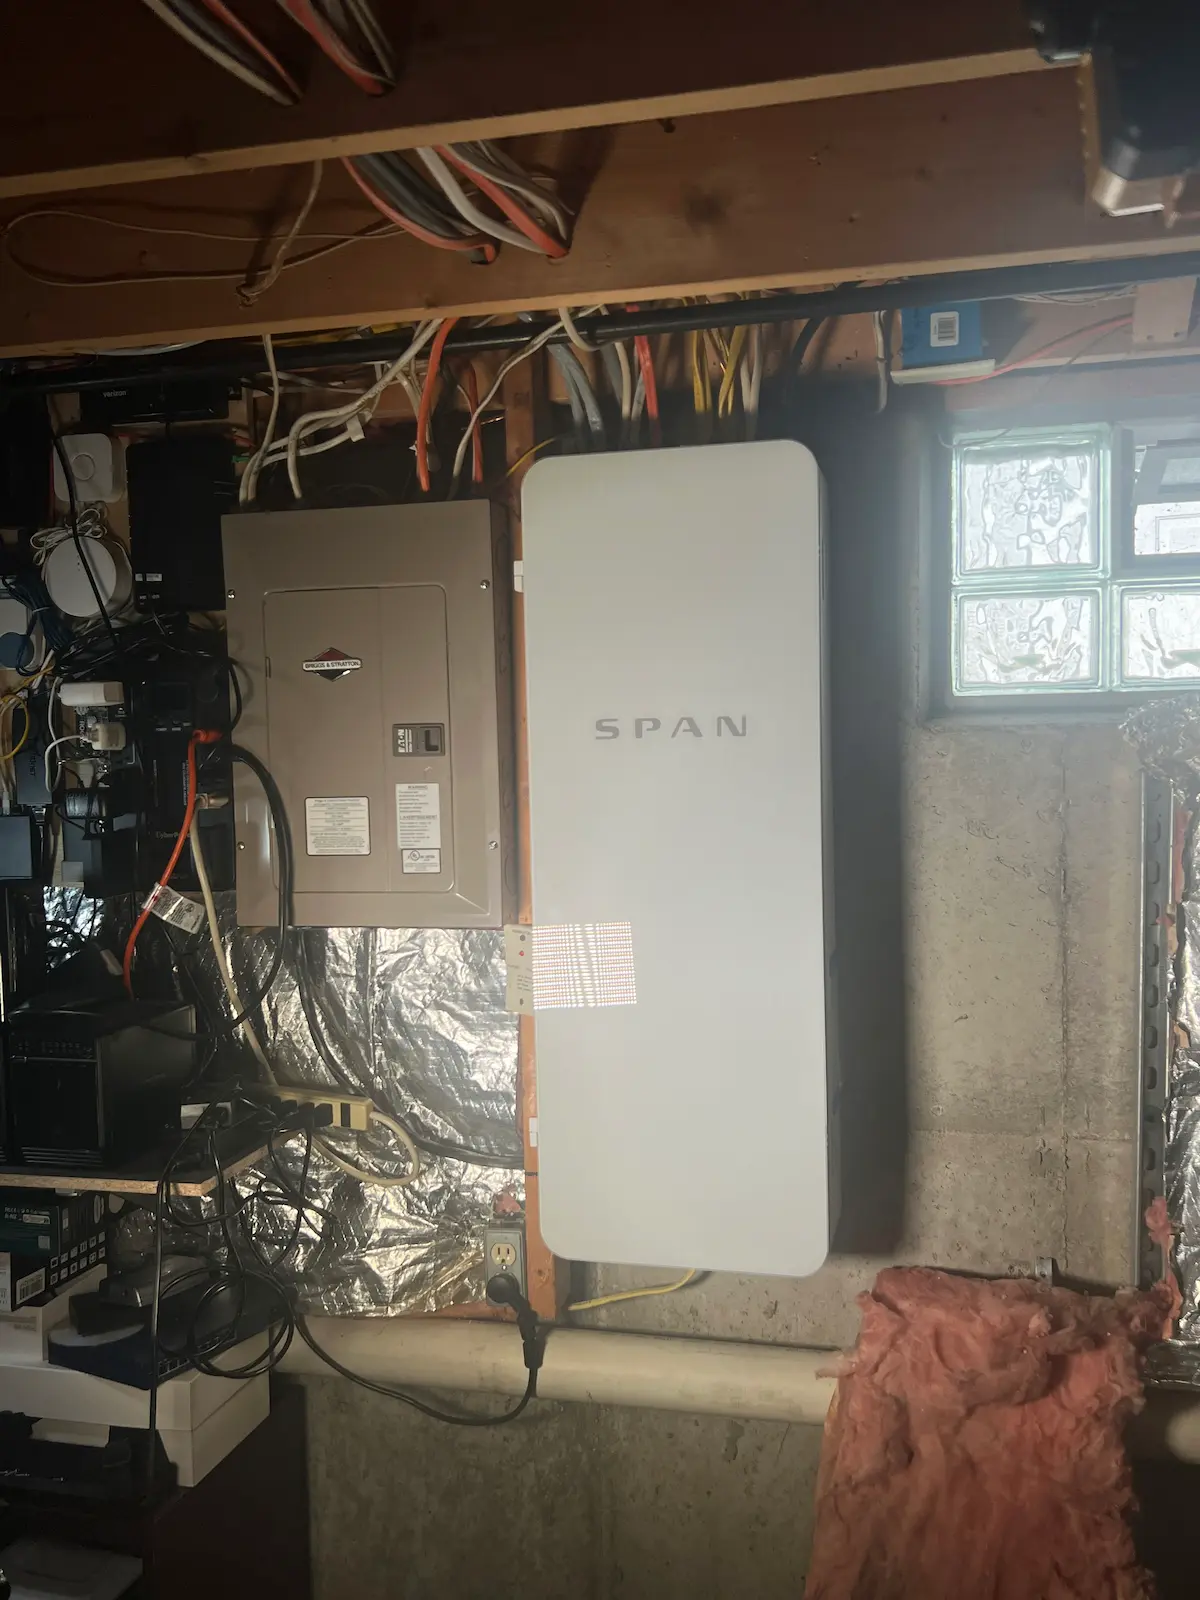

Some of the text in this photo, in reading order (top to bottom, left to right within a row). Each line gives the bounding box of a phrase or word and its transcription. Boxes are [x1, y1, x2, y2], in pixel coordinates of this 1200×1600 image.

[102, 389, 127, 398] verizon
[330, 660, 360, 668] STRATTON
[595, 714, 747, 740] SPAN
